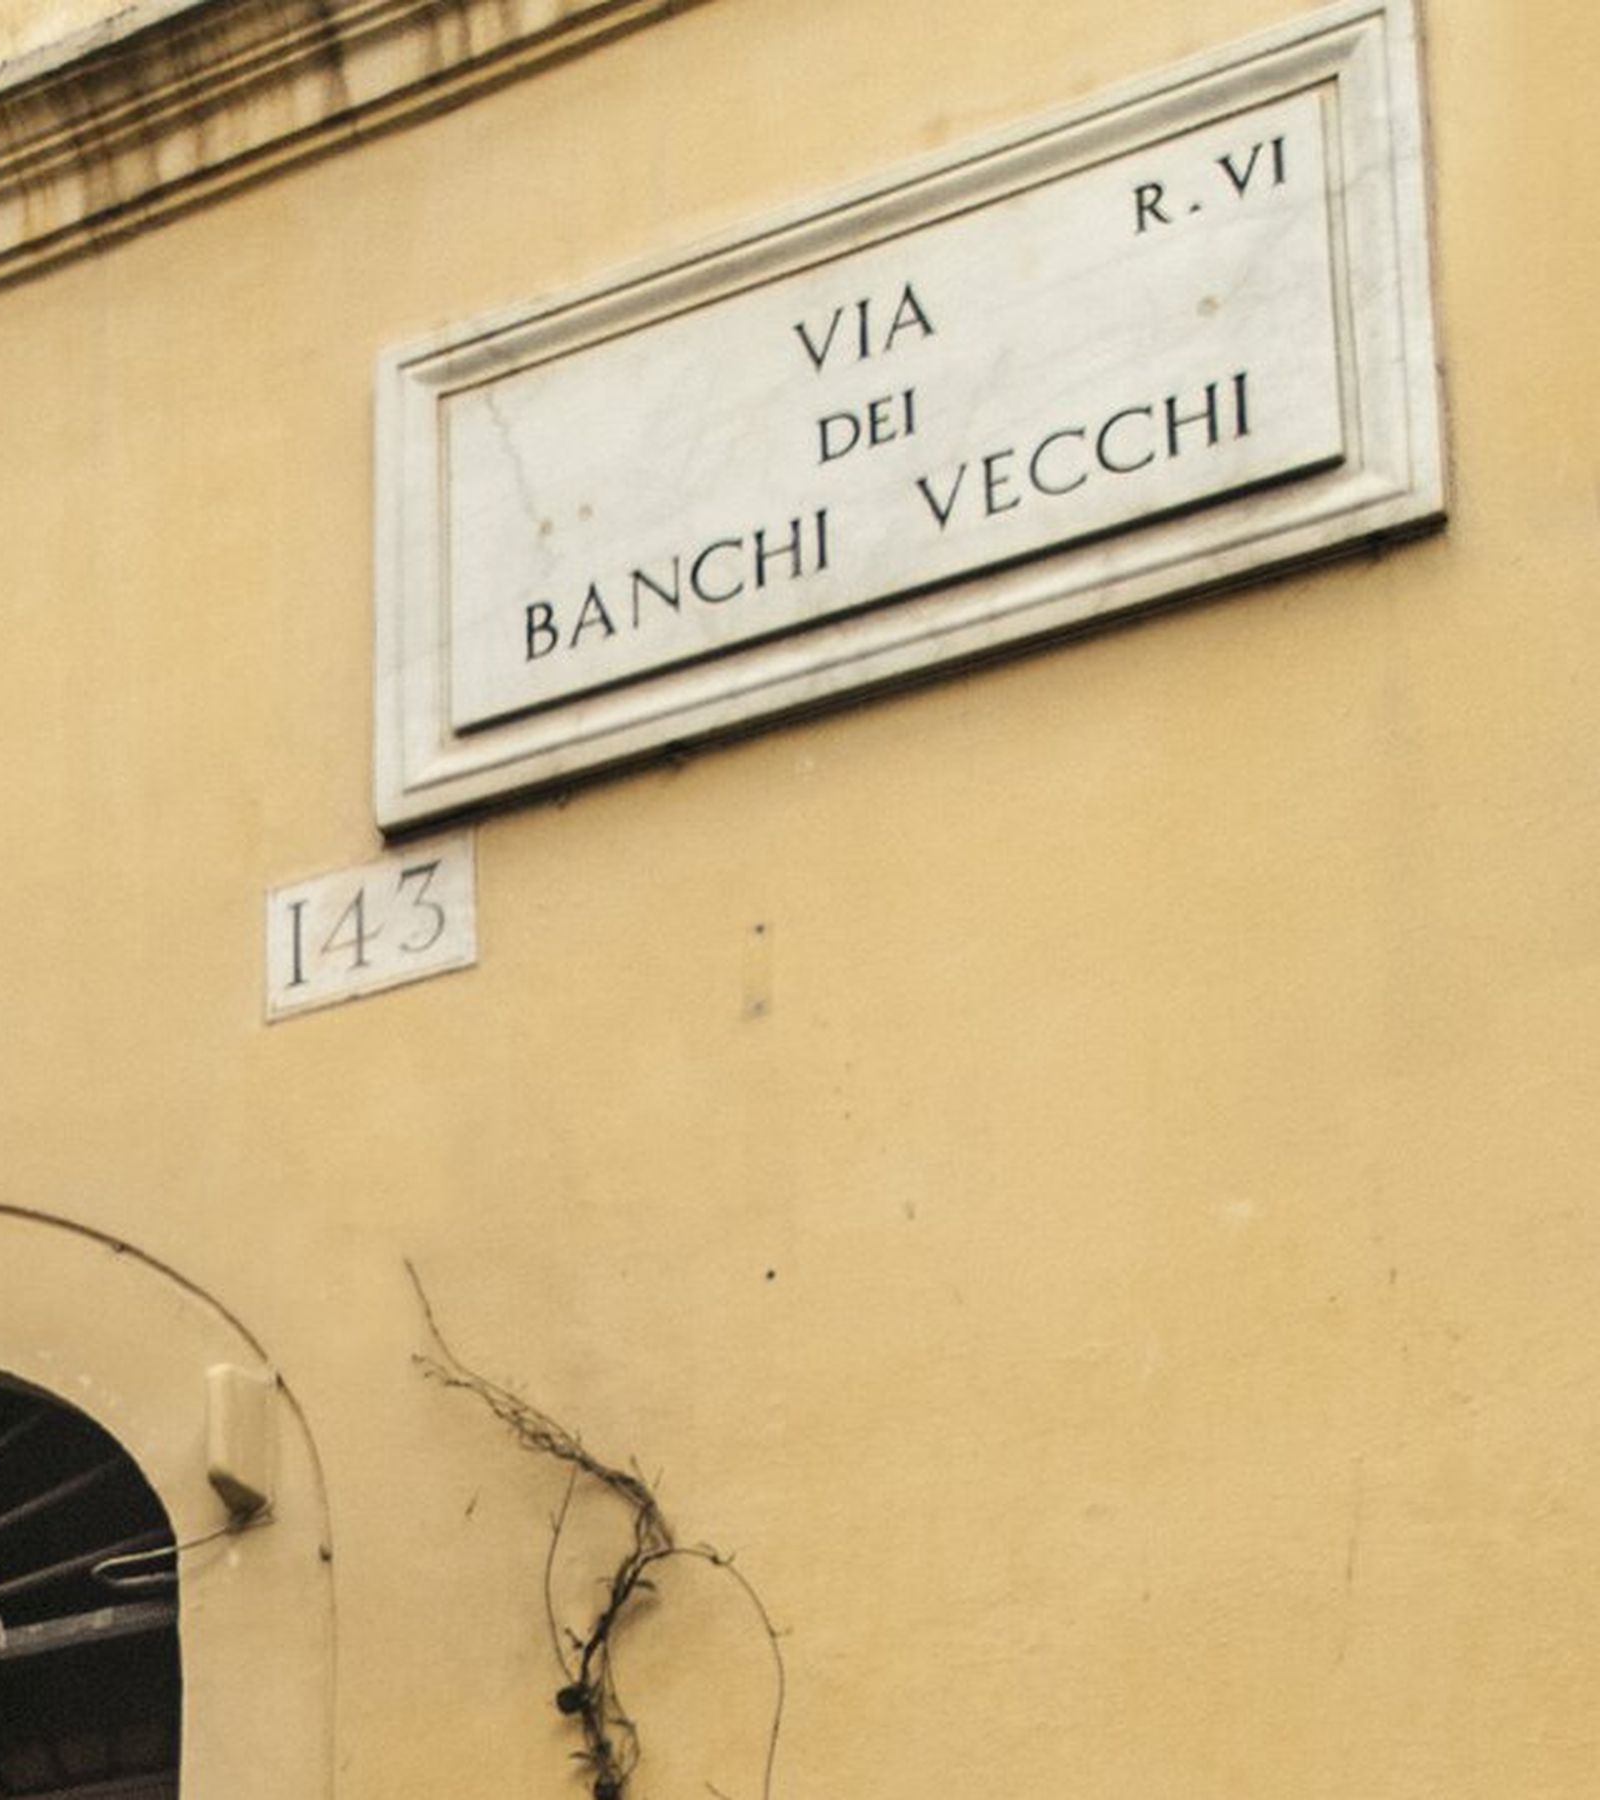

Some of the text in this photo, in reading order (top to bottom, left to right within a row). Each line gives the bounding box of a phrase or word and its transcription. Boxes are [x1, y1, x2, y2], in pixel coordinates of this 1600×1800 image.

[1215, 134, 1288, 198] VI
[793, 281, 936, 372] VIA
[817, 388, 917, 466] DEI
[523, 371, 1252, 662] BANCHI VECCHI
[285, 858, 446, 989] 143
